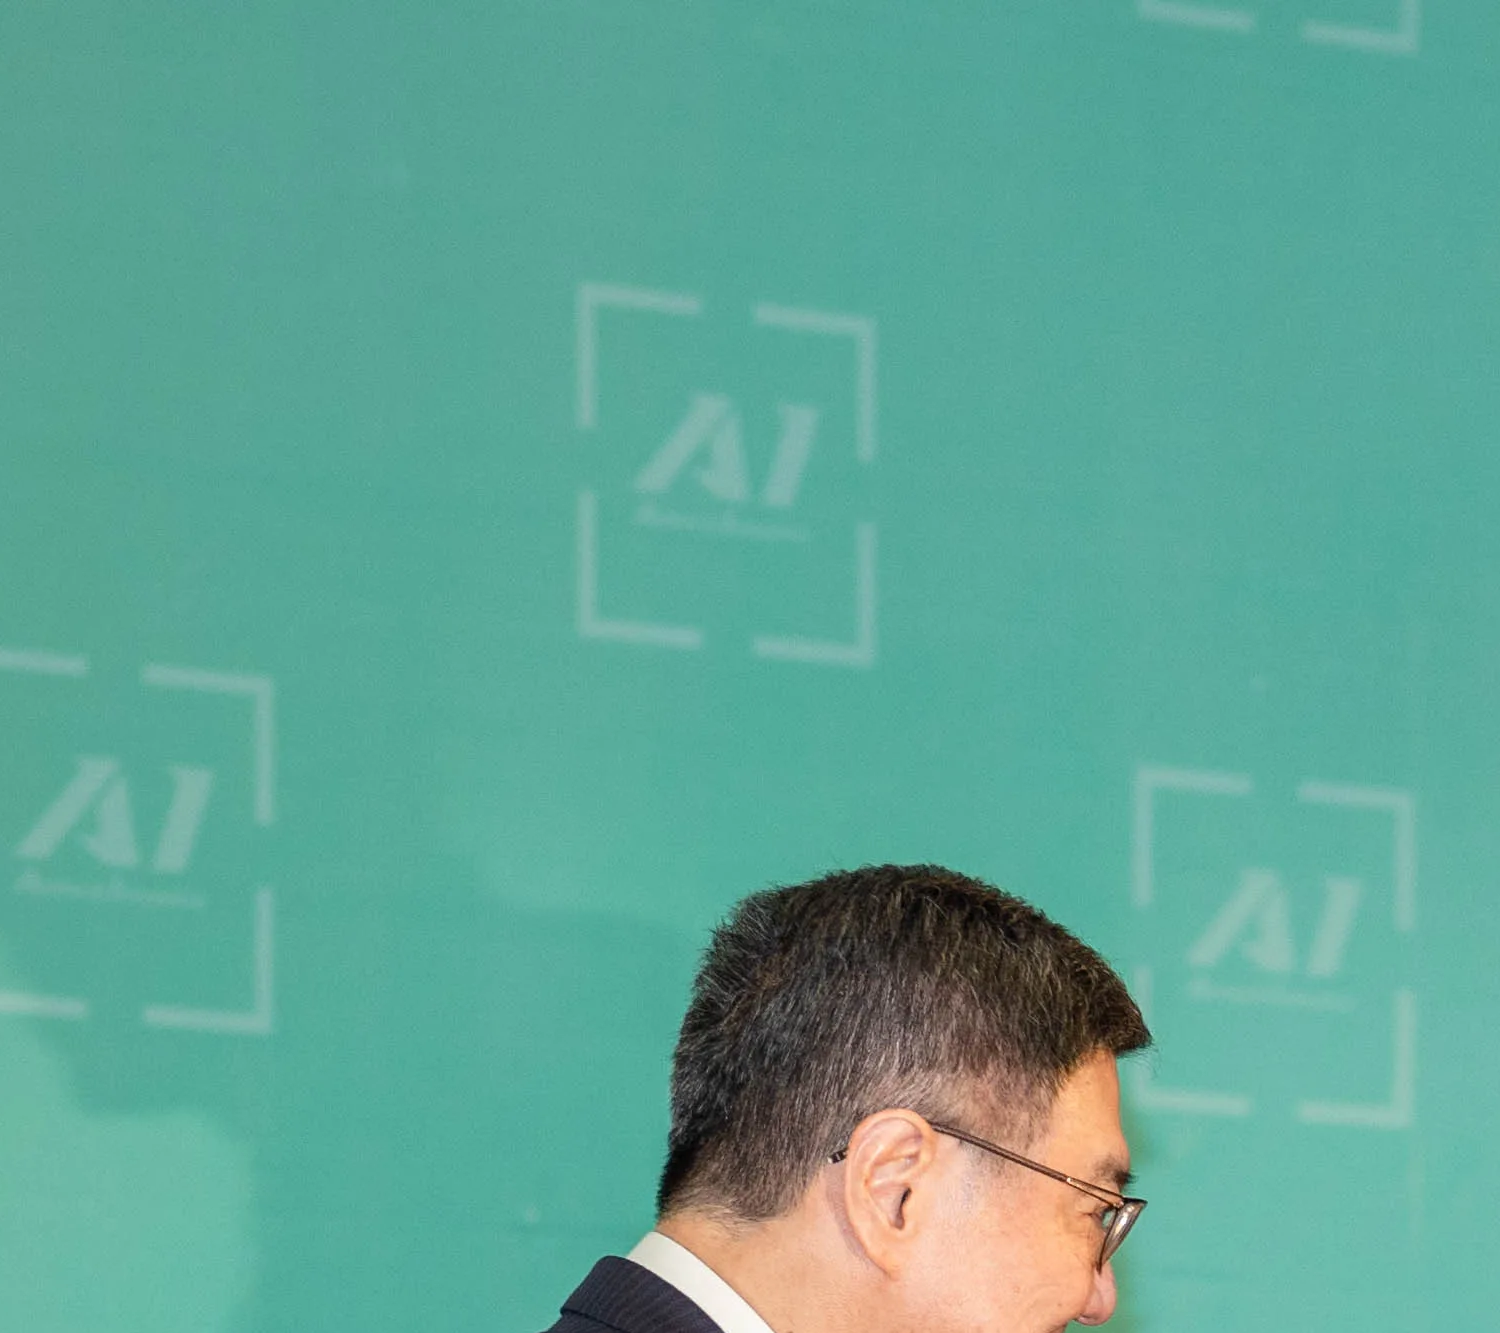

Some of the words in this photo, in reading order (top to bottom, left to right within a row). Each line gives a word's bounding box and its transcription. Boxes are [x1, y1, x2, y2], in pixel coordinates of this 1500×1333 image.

[632, 391, 819, 508] AI
[11, 754, 215, 874] AI
[1187, 867, 1363, 978] AI
